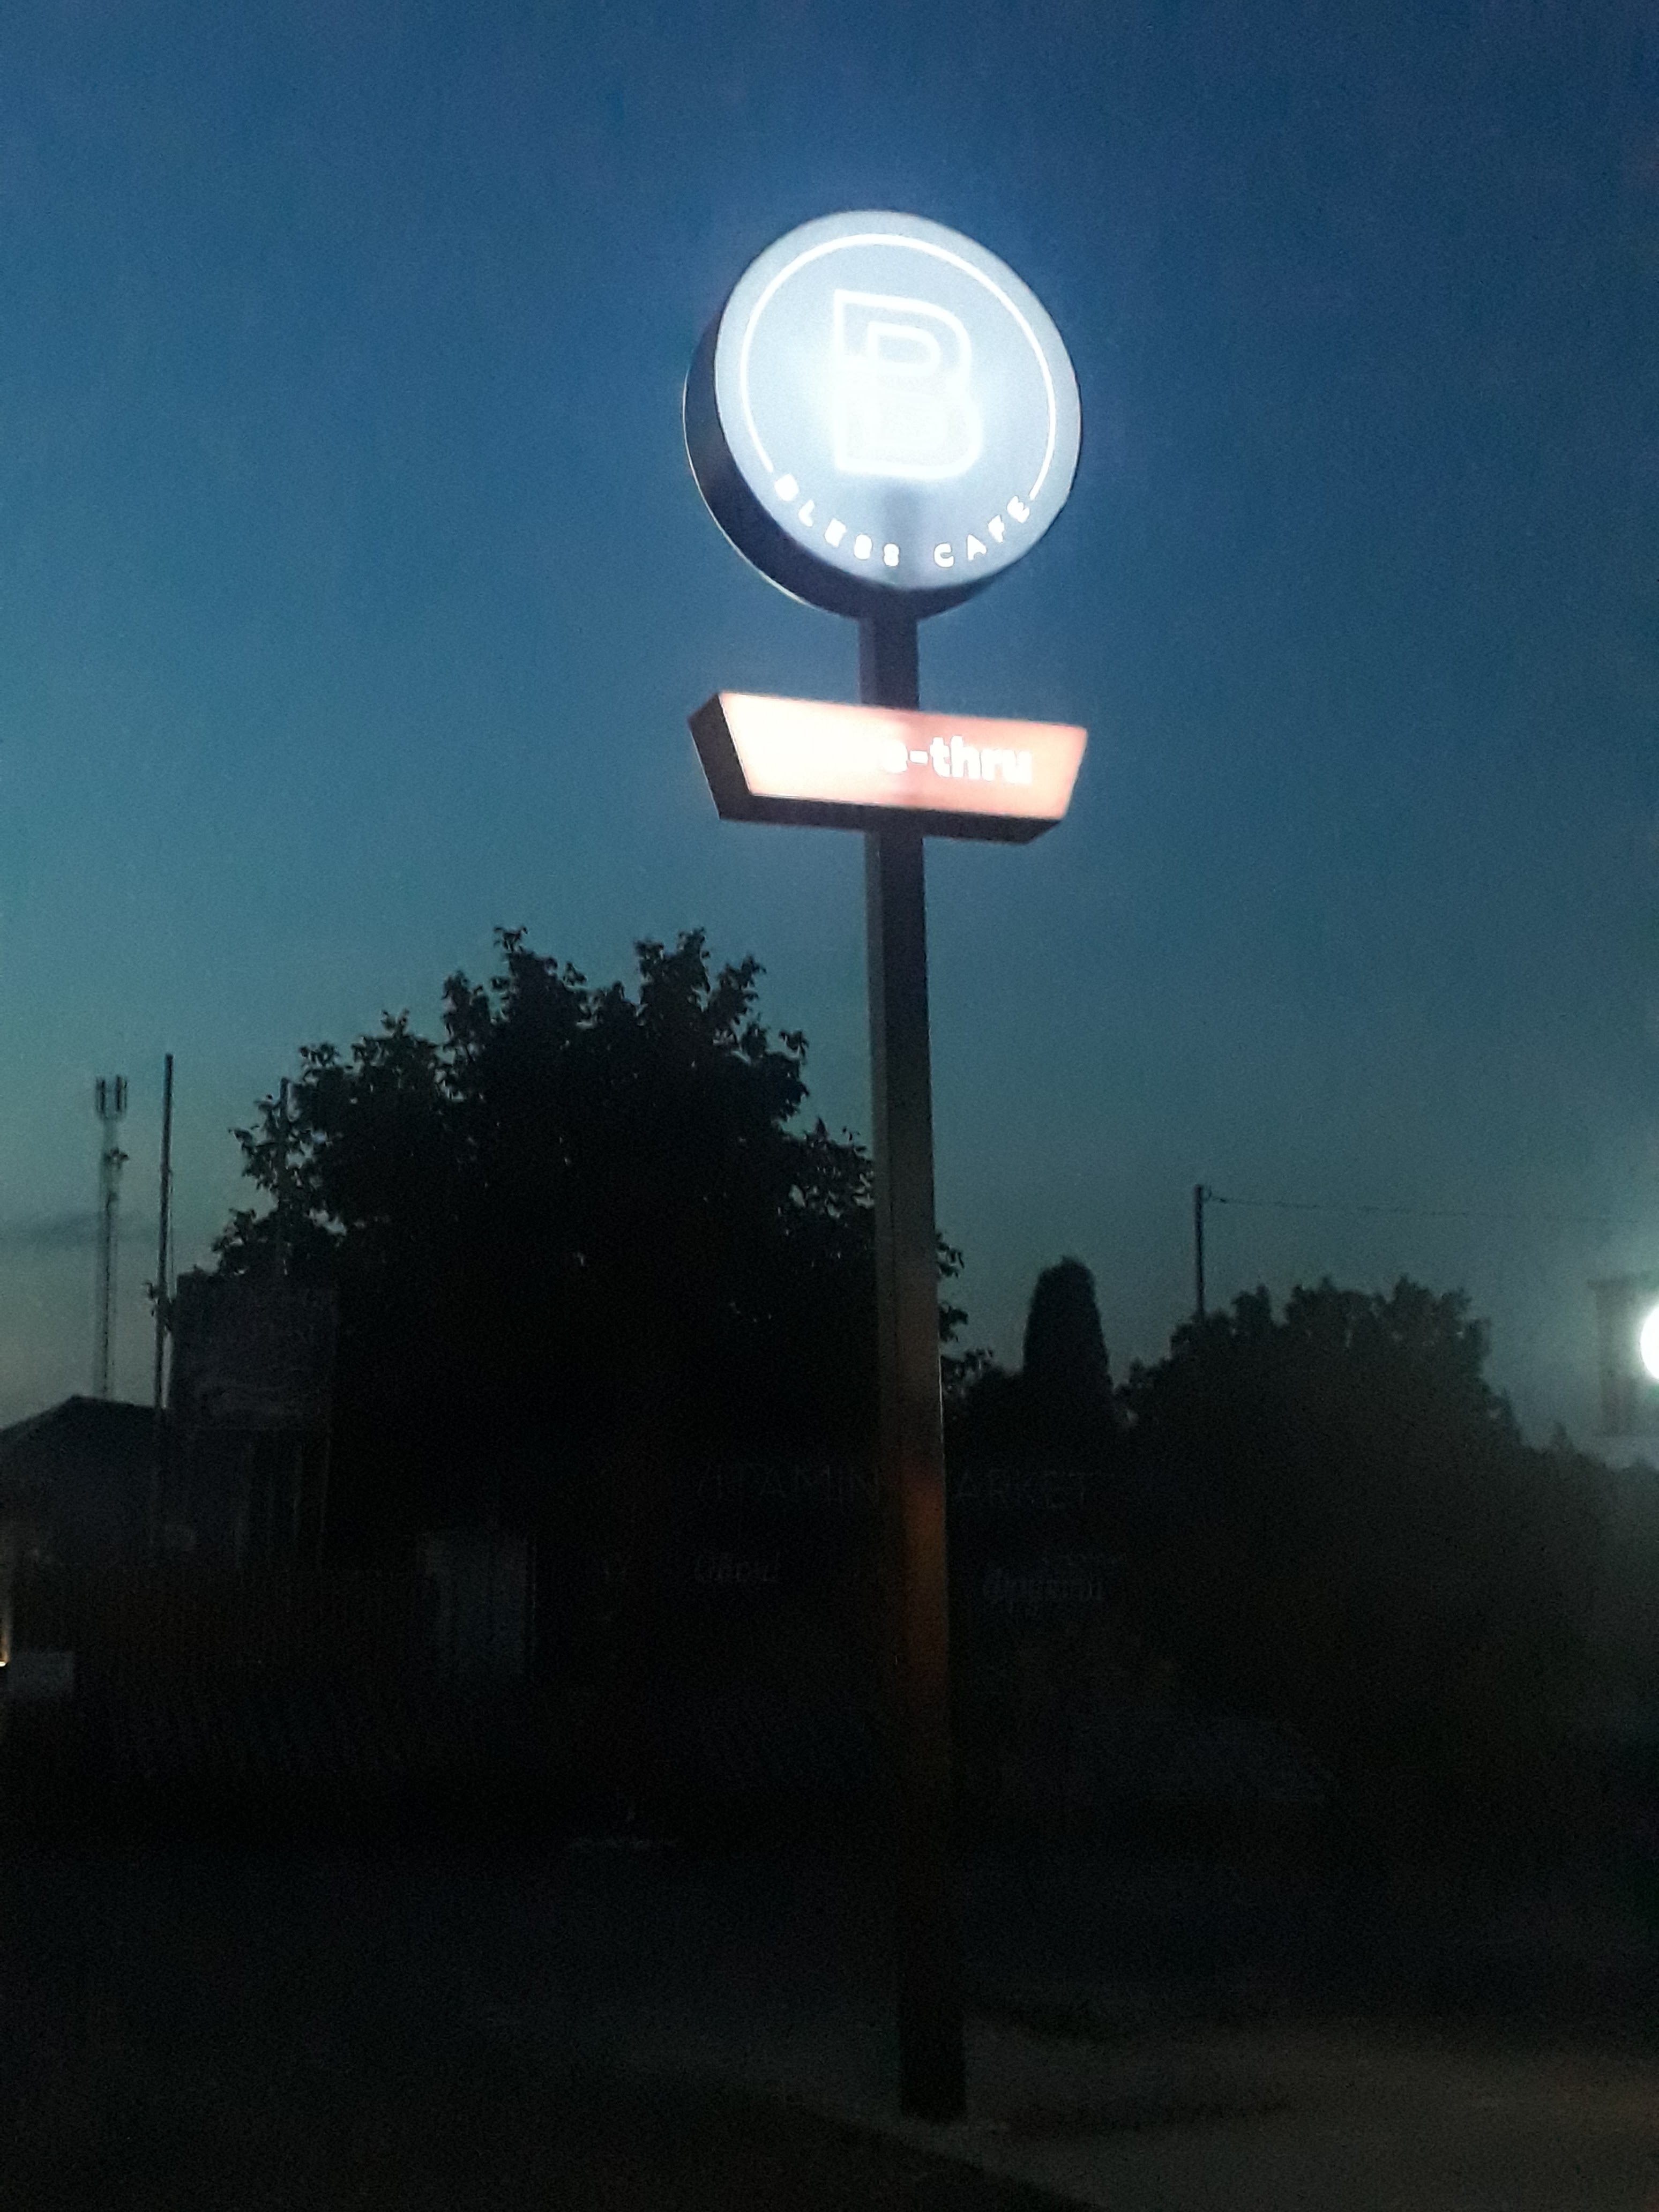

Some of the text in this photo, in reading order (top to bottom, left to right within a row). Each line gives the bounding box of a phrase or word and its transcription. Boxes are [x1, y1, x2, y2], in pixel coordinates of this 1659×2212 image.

[834, 288, 984, 479] B
[934, 495, 1030, 569] CAFE
[955, 1468, 1098, 1509] ARKET
